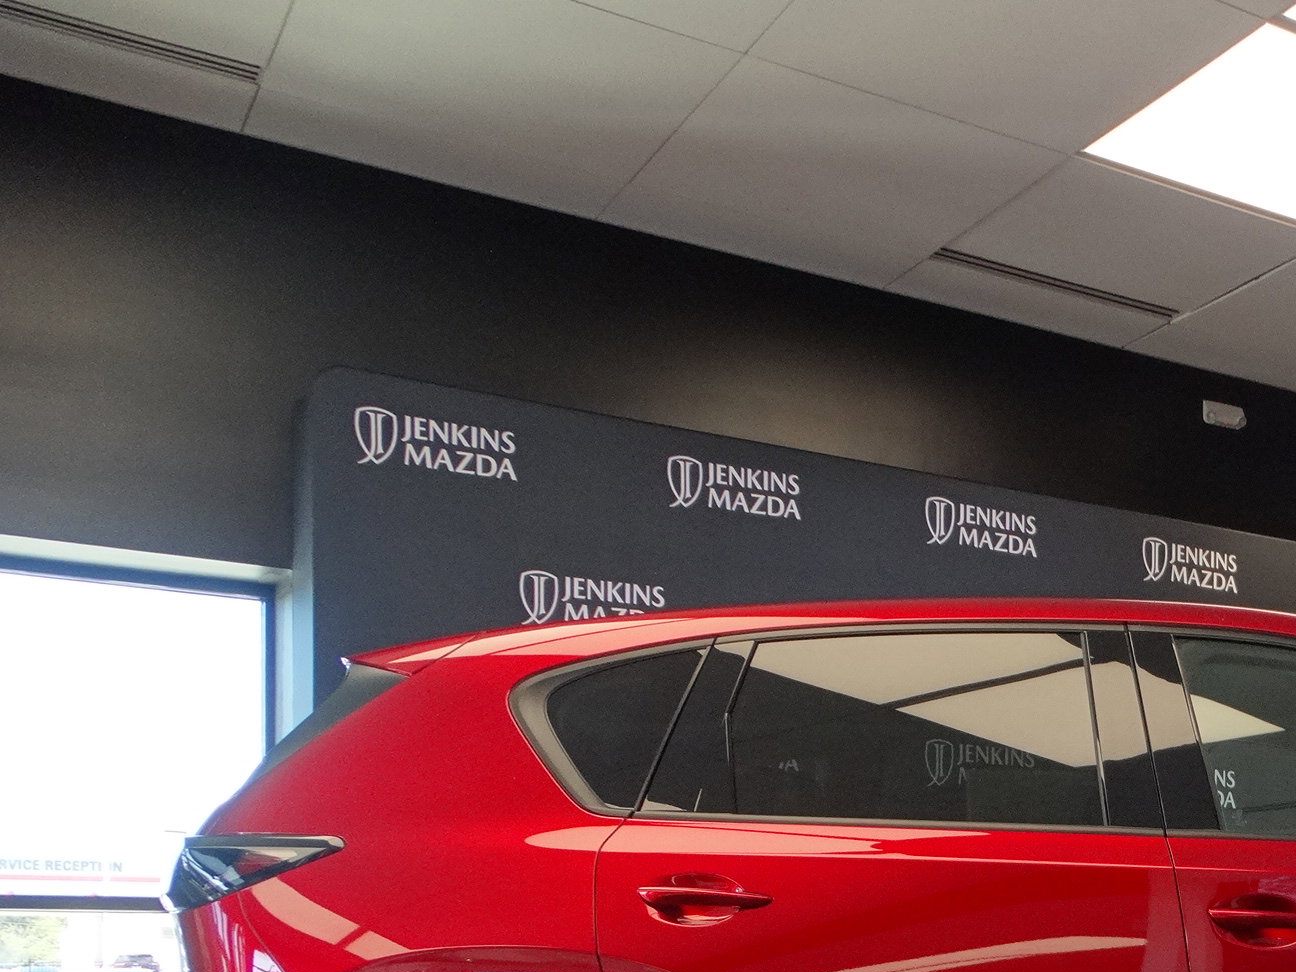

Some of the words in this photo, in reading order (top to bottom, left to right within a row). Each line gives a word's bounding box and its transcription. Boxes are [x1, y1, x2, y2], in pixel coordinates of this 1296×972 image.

[401, 414, 516, 454] JENKINS
[404, 443, 518, 482] MAZDA
[705, 461, 800, 496] JENKINS
[707, 487, 801, 520] MAZDA
[957, 503, 1037, 535] JENKINS
[958, 526, 1038, 558] MAZDA
[1169, 542, 1238, 573] JENKINS
[561, 576, 666, 608] JENKINS
[1170, 564, 1238, 594] MAZDA
[957, 743, 1035, 769] JENKINS
[0, 859, 40, 871] RVICE
[45, 860, 123, 873] RECEPTIN
